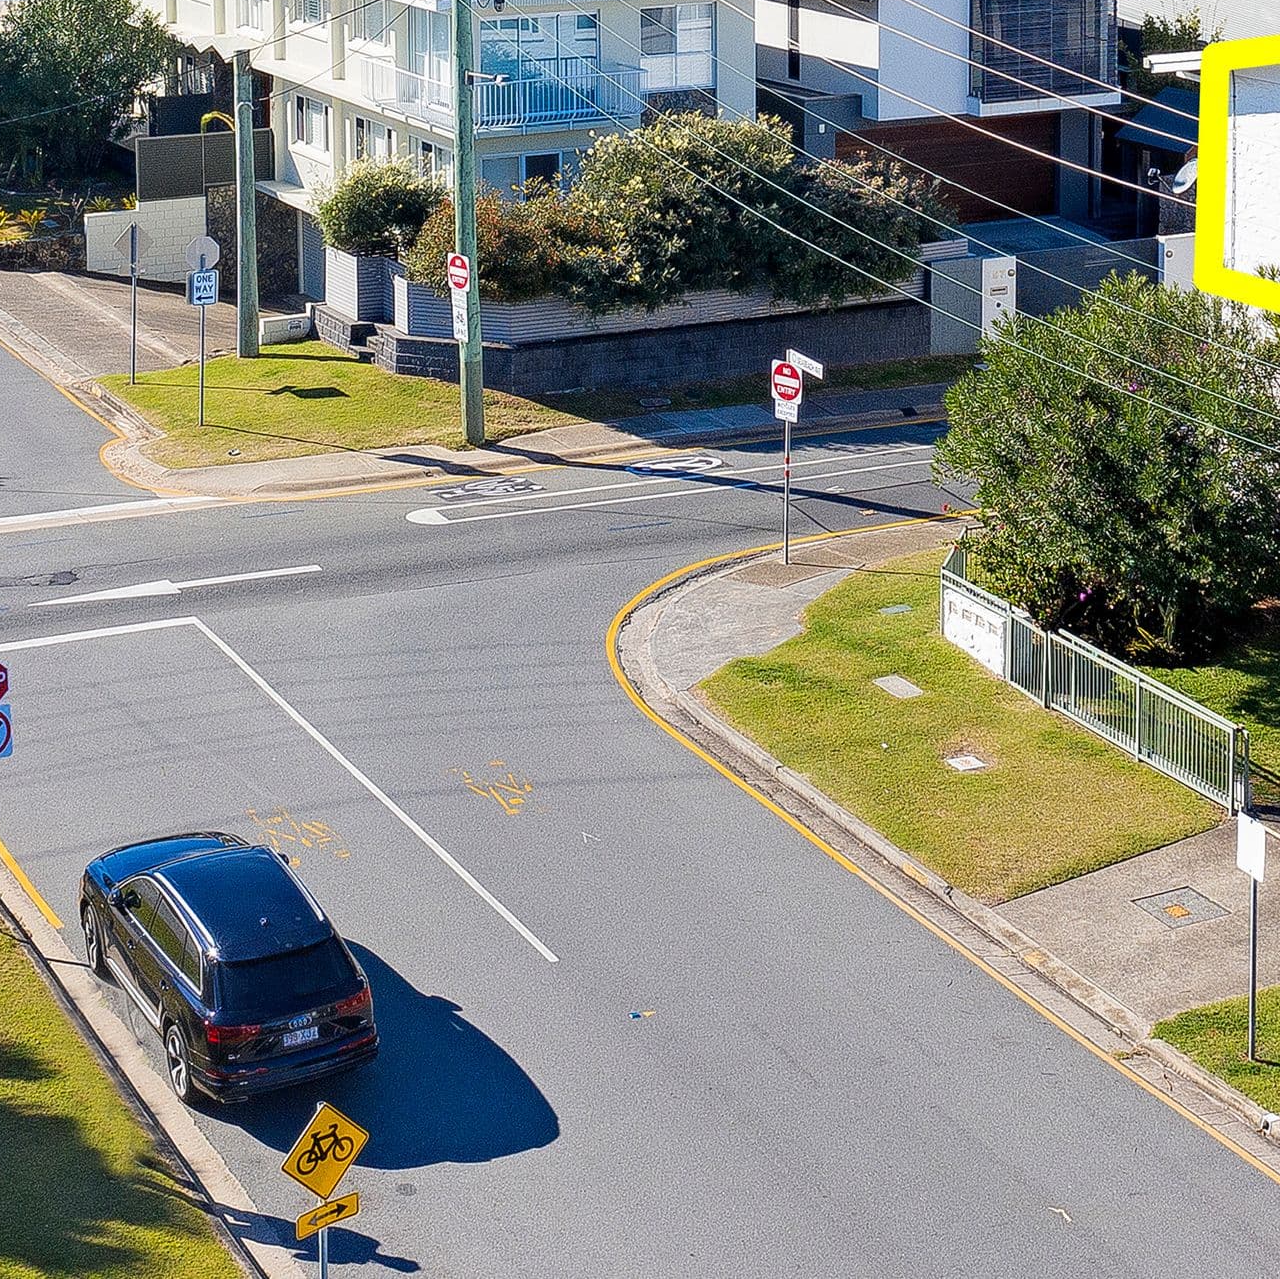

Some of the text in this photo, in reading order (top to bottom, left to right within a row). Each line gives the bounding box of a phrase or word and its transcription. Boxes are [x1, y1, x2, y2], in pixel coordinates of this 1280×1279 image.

[196, 274, 213, 283] ONE
[195, 284, 214, 293] WAY
[782, 367, 792, 375] NO
[777, 385, 796, 396] ENTRY
